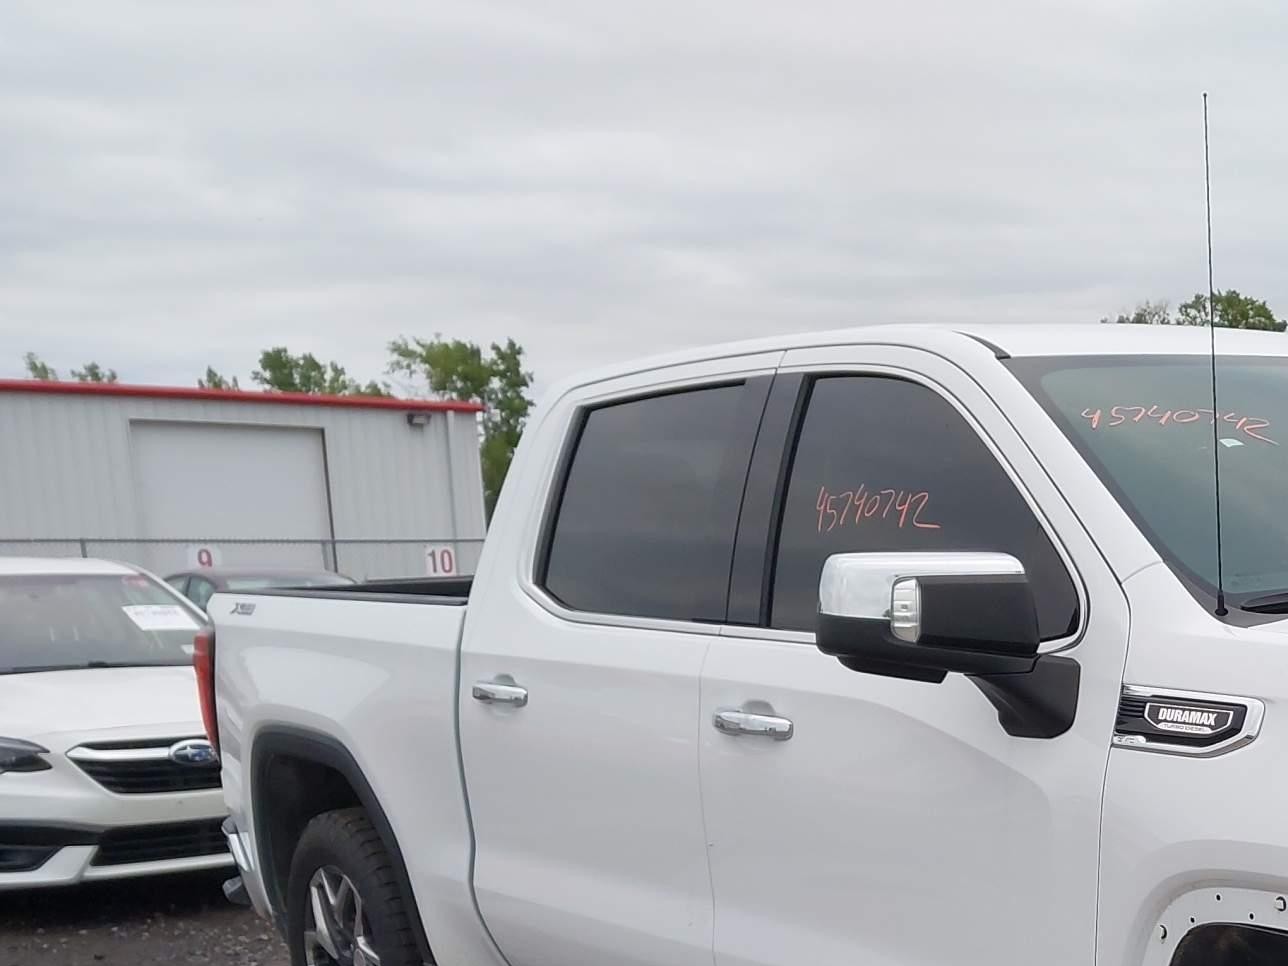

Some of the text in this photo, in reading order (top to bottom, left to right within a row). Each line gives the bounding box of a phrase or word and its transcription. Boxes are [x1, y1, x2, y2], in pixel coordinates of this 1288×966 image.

[1081, 405, 1280, 446] 45740742
[816, 483, 941, 532] 45740742
[427, 549, 453, 573] 10
[1158, 707, 1217, 726] DURAMAX
